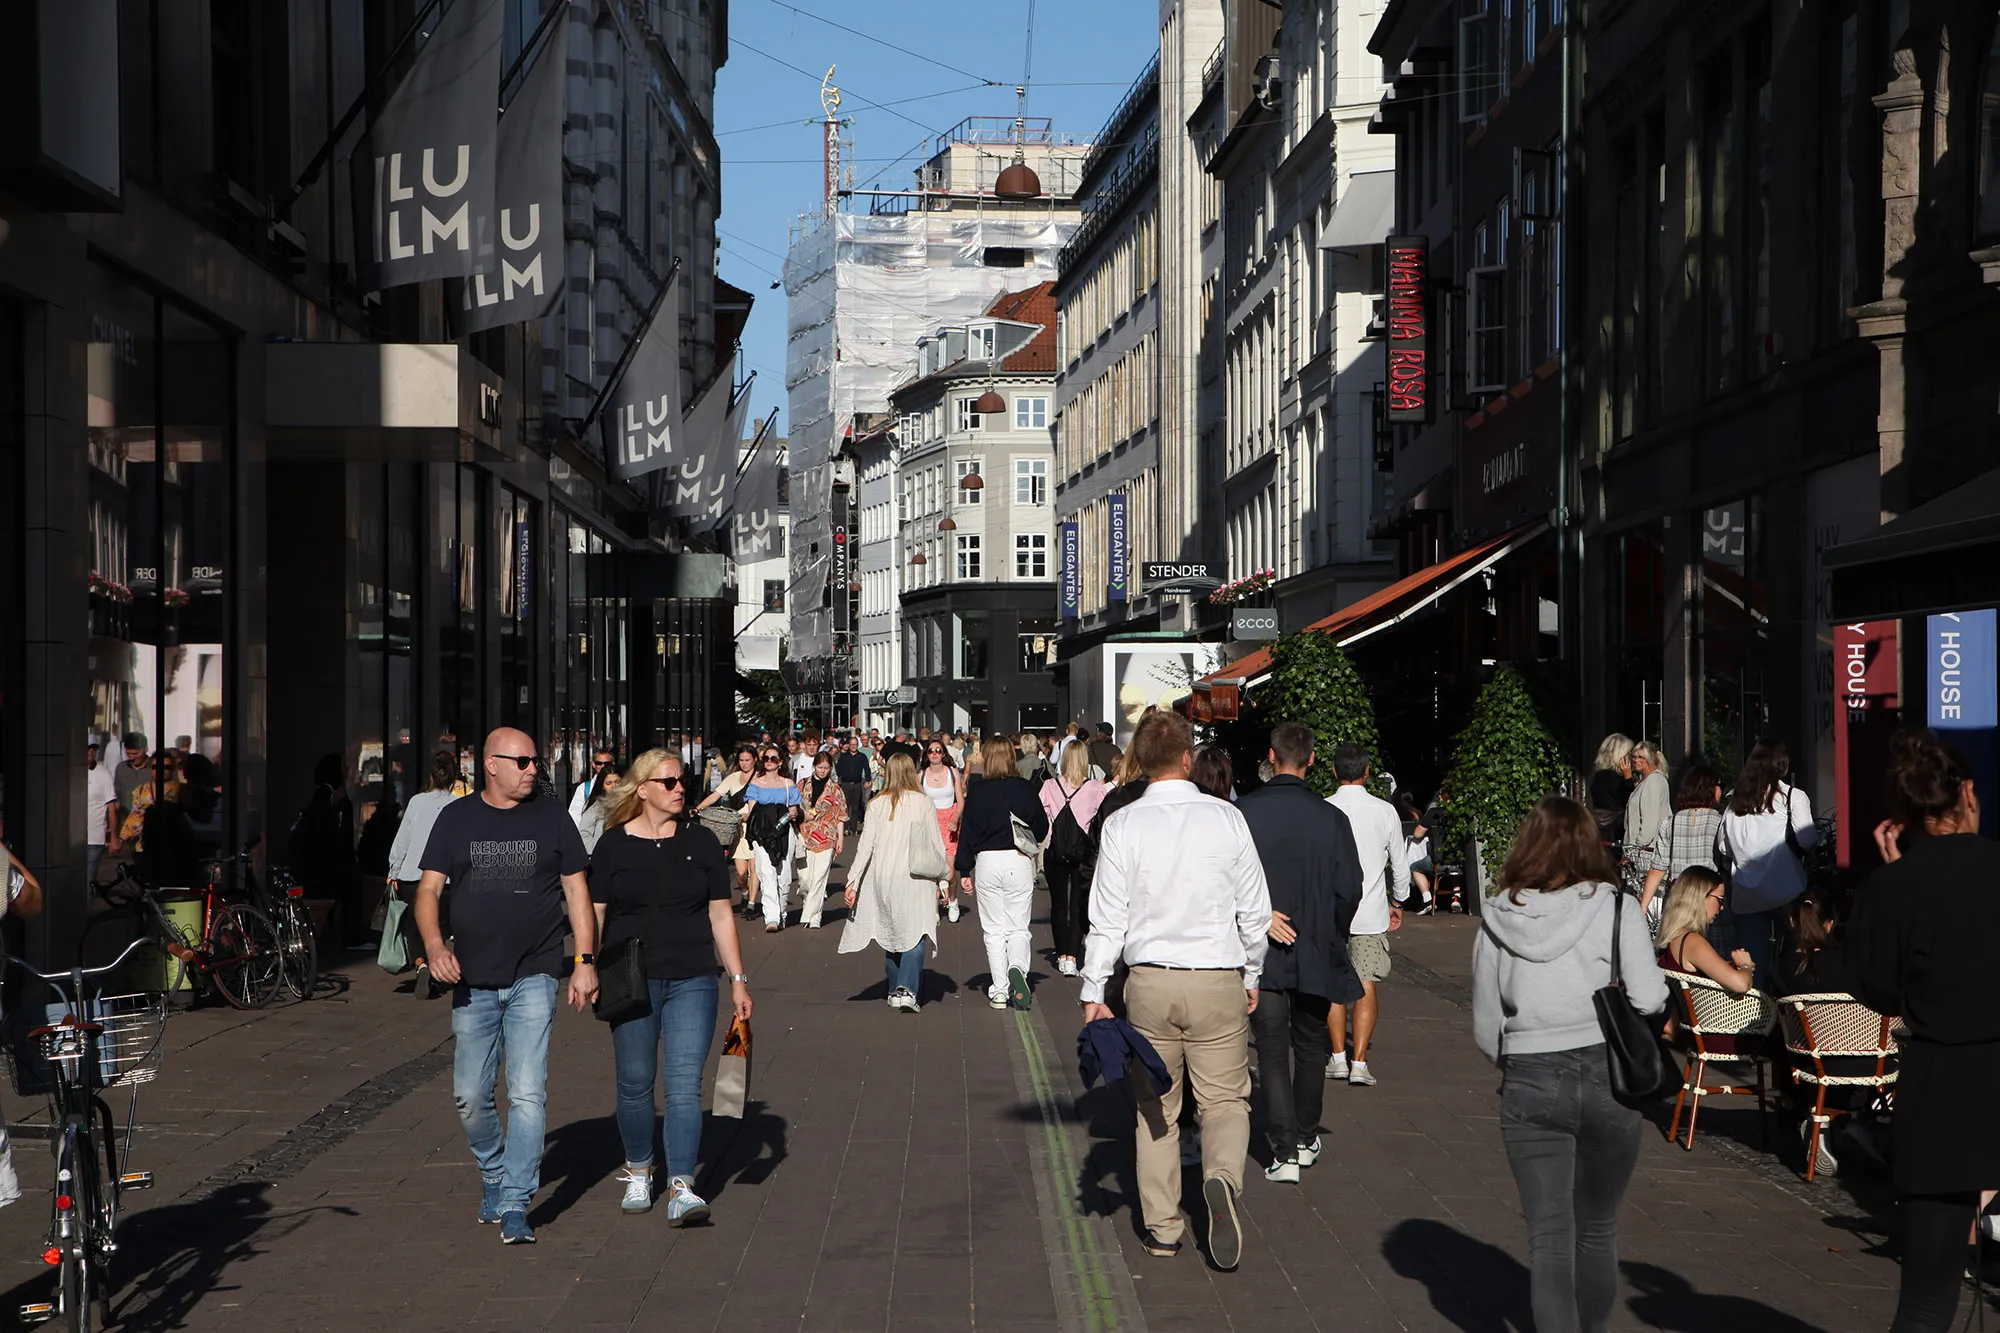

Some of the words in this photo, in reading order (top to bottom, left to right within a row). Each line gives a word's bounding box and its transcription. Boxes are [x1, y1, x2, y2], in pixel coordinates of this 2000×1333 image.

[1391, 249, 1426, 340] MAMMA
[1391, 349, 1427, 410] ROSA
[835, 525, 846, 589] COMPANYS
[1066, 530, 1076, 600] ELGIGANTEN
[1113, 503, 1123, 582] ELGIGANTEN
[1150, 565, 1208, 577] STENDER
[1237, 618, 1275, 629] ecco
[1847, 643, 1866, 724] HOUSE
[1941, 632, 1961, 720] HOUSE
[471, 840, 537, 855] REBOUND
